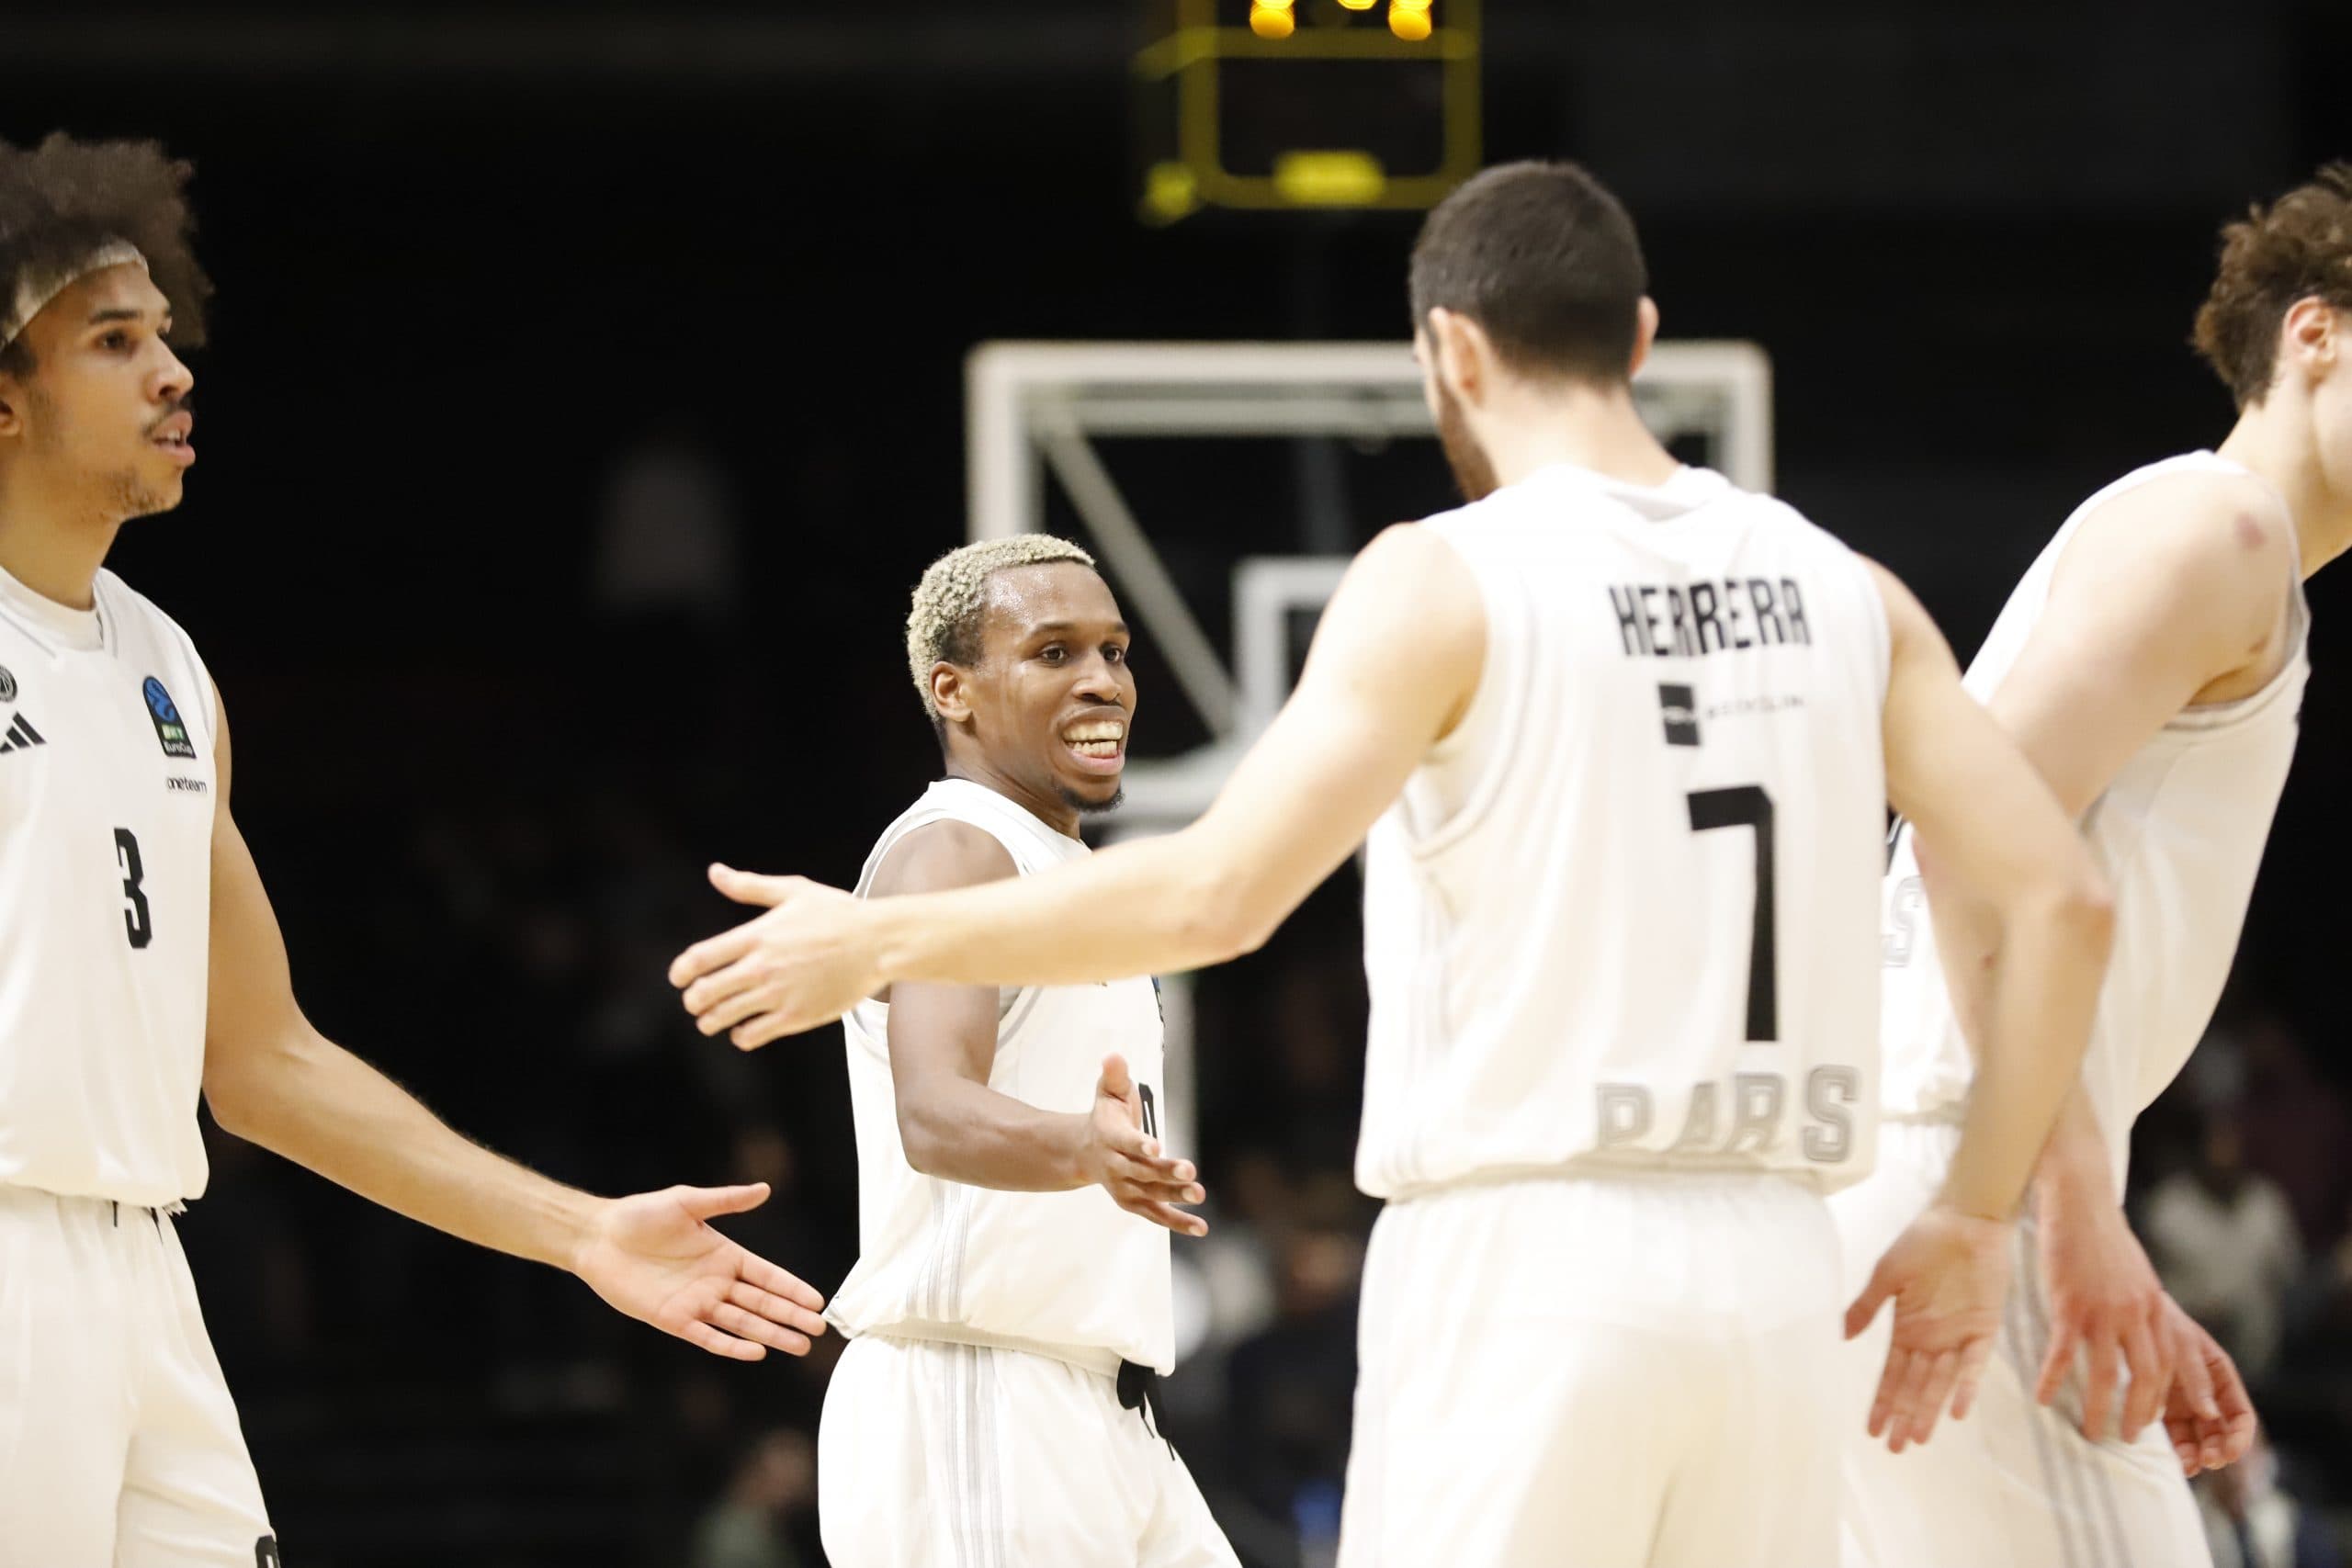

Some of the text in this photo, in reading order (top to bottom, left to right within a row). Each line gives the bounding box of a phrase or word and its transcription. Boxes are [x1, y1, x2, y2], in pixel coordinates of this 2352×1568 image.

[1608, 576, 1812, 657] HERRERA
[114, 828, 152, 949] 3
[1687, 785, 1779, 1042] 7
